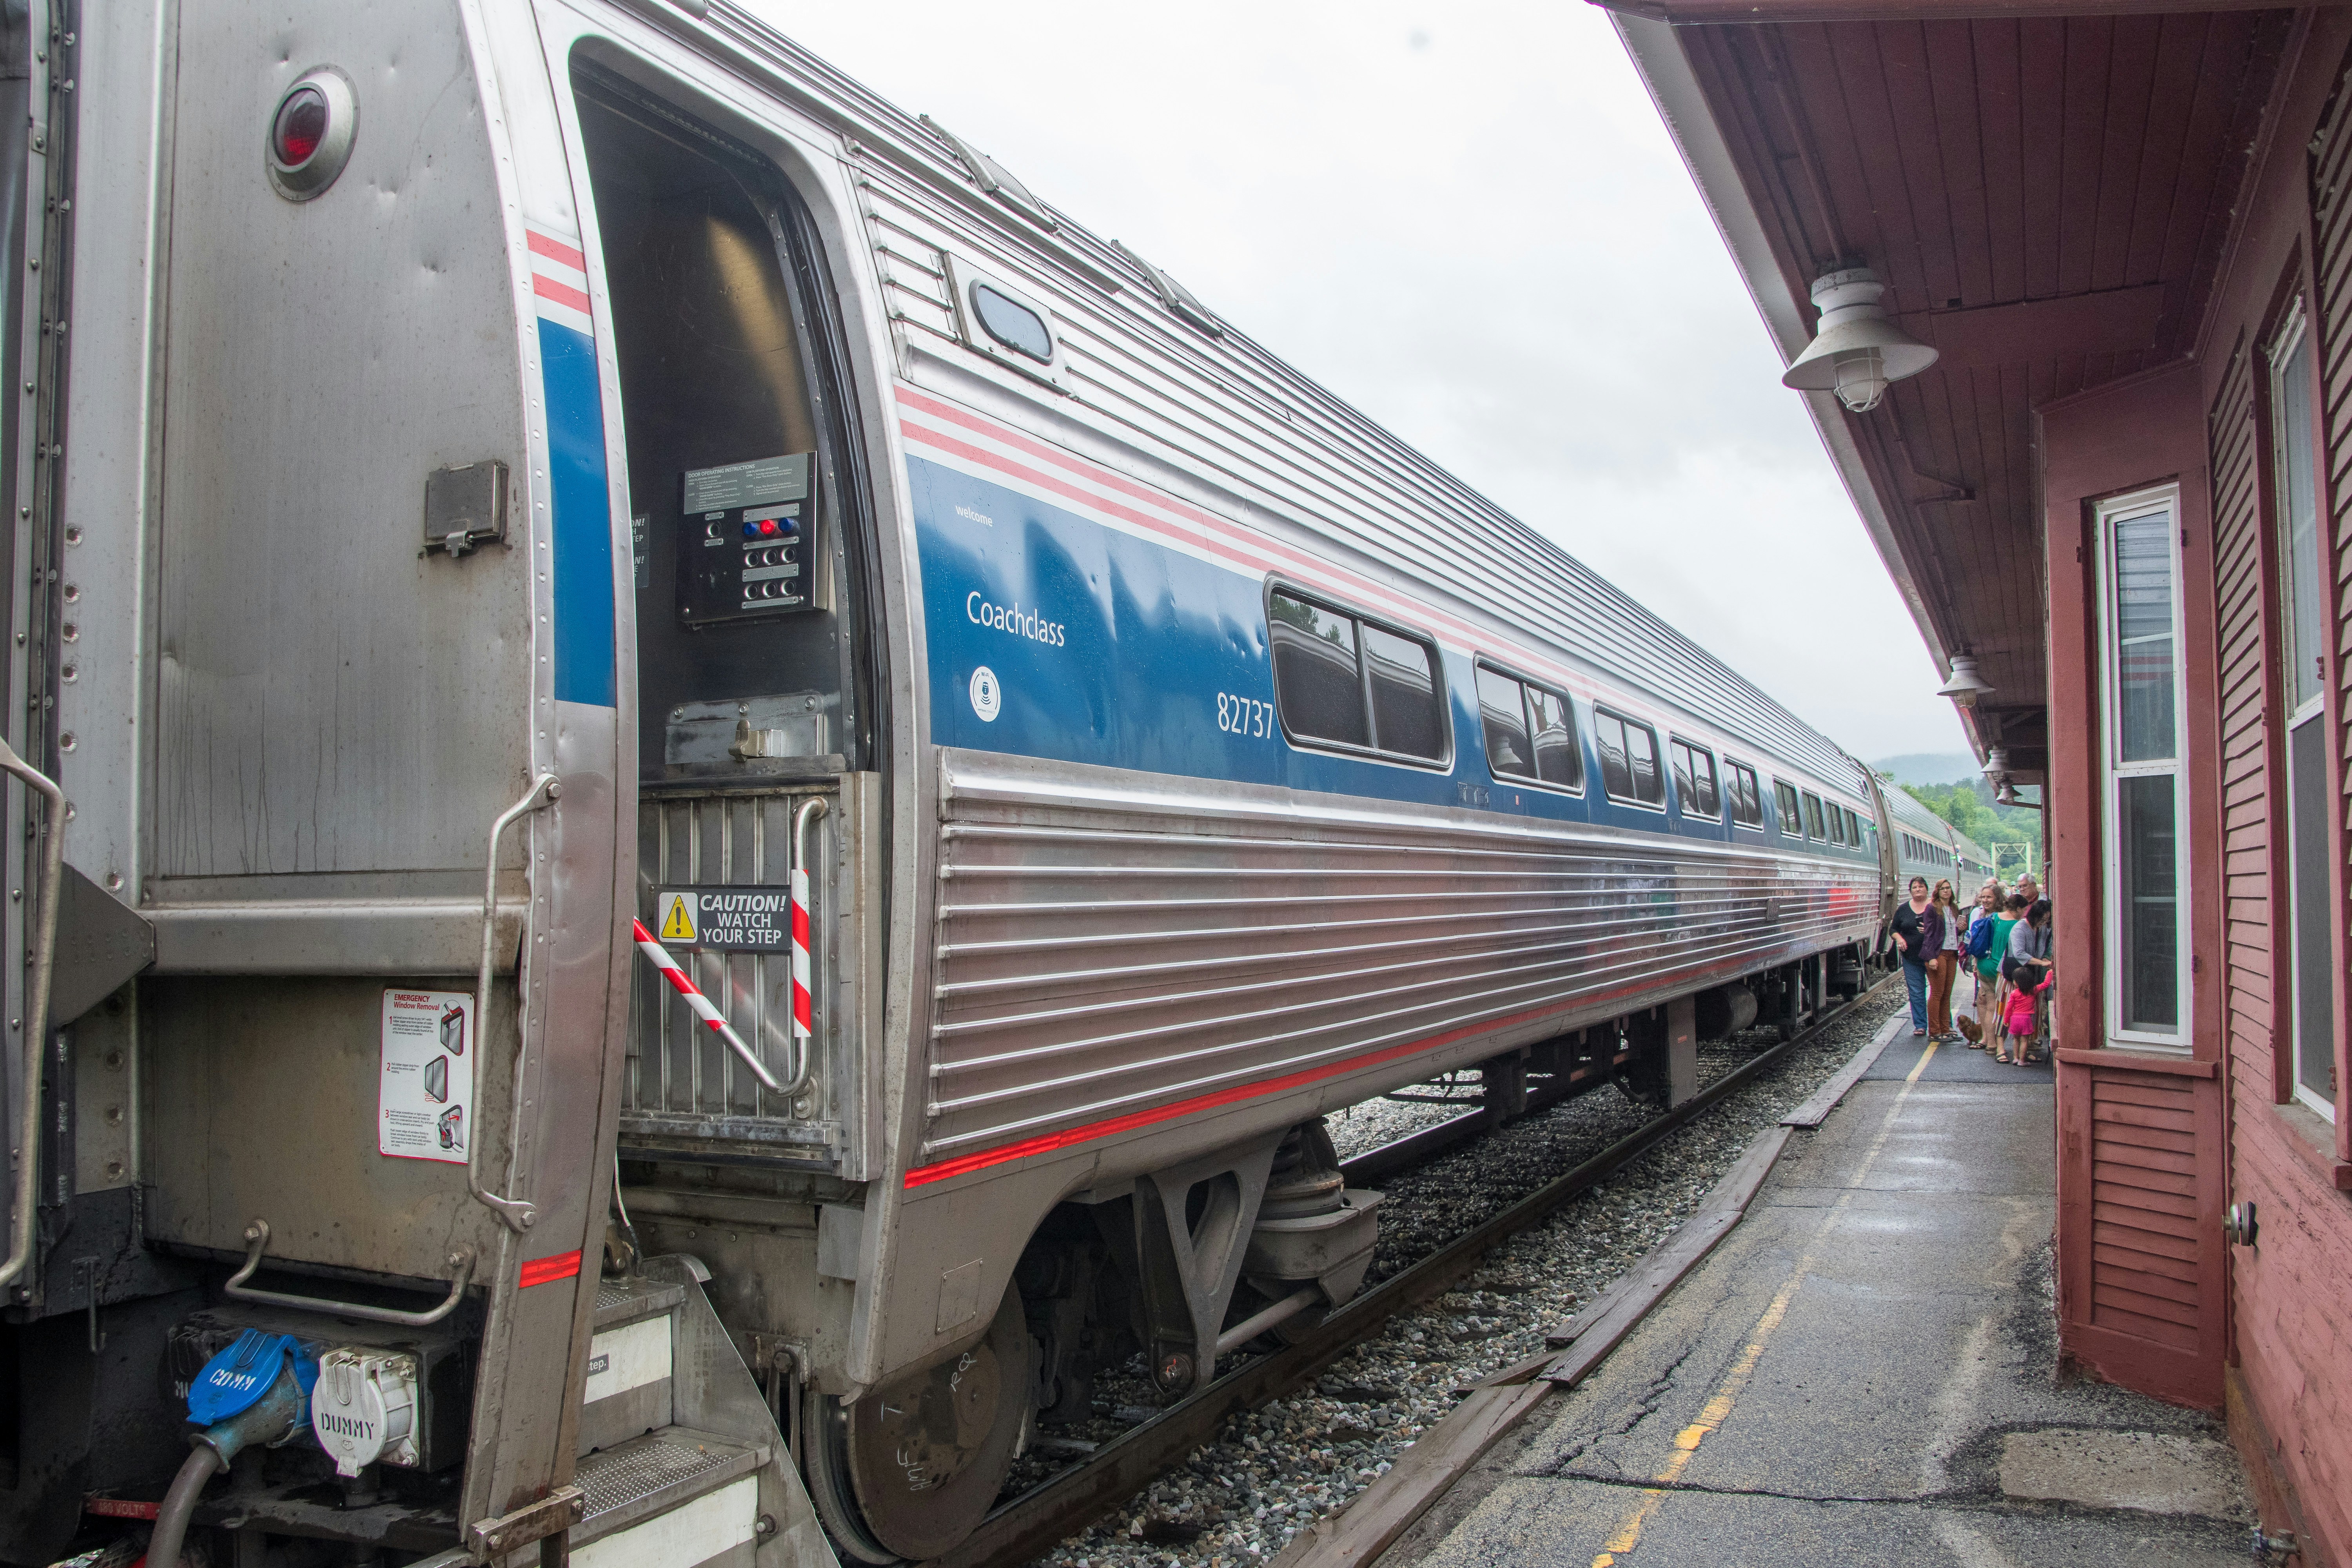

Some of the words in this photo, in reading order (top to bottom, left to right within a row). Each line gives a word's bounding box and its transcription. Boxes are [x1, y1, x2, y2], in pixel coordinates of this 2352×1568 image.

[725, 464, 755, 473] INSTRUCTIONS
[955, 505, 993, 528] welcome
[966, 590, 1065, 648] Coachclass
[1217, 691, 1273, 739] 82737
[700, 895, 786, 911] CAUTION!
[717, 913, 771, 928] WATCH
[702, 928, 744, 943] YOUR
[748, 929, 782, 944] STEP
[389, 1016, 392, 1024] 1
[387, 1062, 390, 1071] 2
[385, 1109, 389, 1118] 3
[588, 1357, 607, 1372] tep.
[209, 1368, 257, 1392] COMM
[321, 1412, 375, 1440] DUMMY
